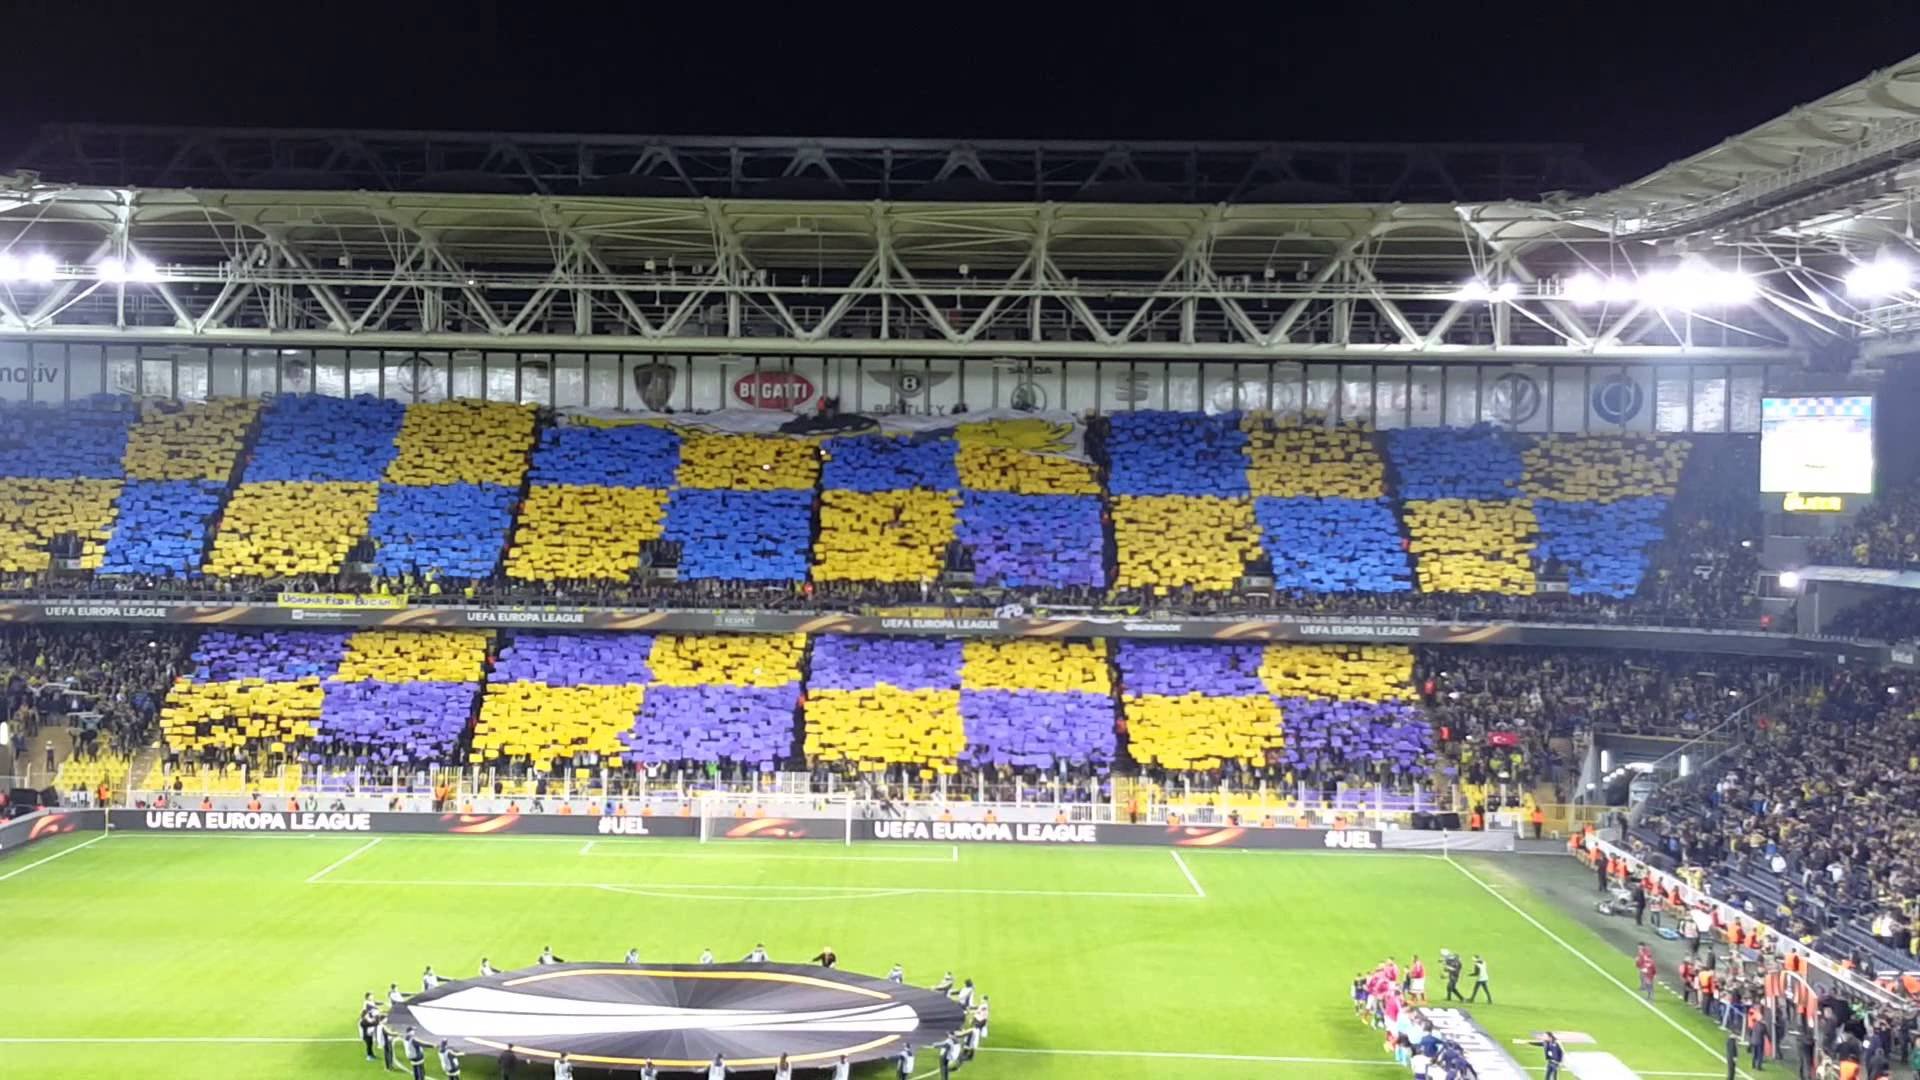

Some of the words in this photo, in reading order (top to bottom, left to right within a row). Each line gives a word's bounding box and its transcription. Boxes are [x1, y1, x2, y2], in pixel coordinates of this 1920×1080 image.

[45, 607, 75, 616] UEFA
[78, 607, 120, 616] EUROPA
[123, 607, 166, 617] LEAGUE
[467, 612, 496, 621] UEFA
[499, 613, 540, 622] EUROPA
[542, 614, 584, 623] LEAGUE
[881, 618, 911, 628] UEFA
[912, 619, 955, 629] EUROPA
[956, 620, 999, 629] LEAGUE
[1300, 625, 1330, 634] UEFA
[1331, 626, 1375, 635] EUROPA
[1376, 627, 1419, 637] LEAGUE
[146, 811, 201, 829] UEFA
[205, 812, 287, 830] EUROPA
[290, 814, 371, 831] LEAGUE
[598, 816, 649, 834] #UEL
[874, 821, 929, 839] UEFA
[932, 822, 1013, 841] EUROPA
[1016, 823, 1096, 842] LEAGUE
[1324, 830, 1377, 848] #UEL
